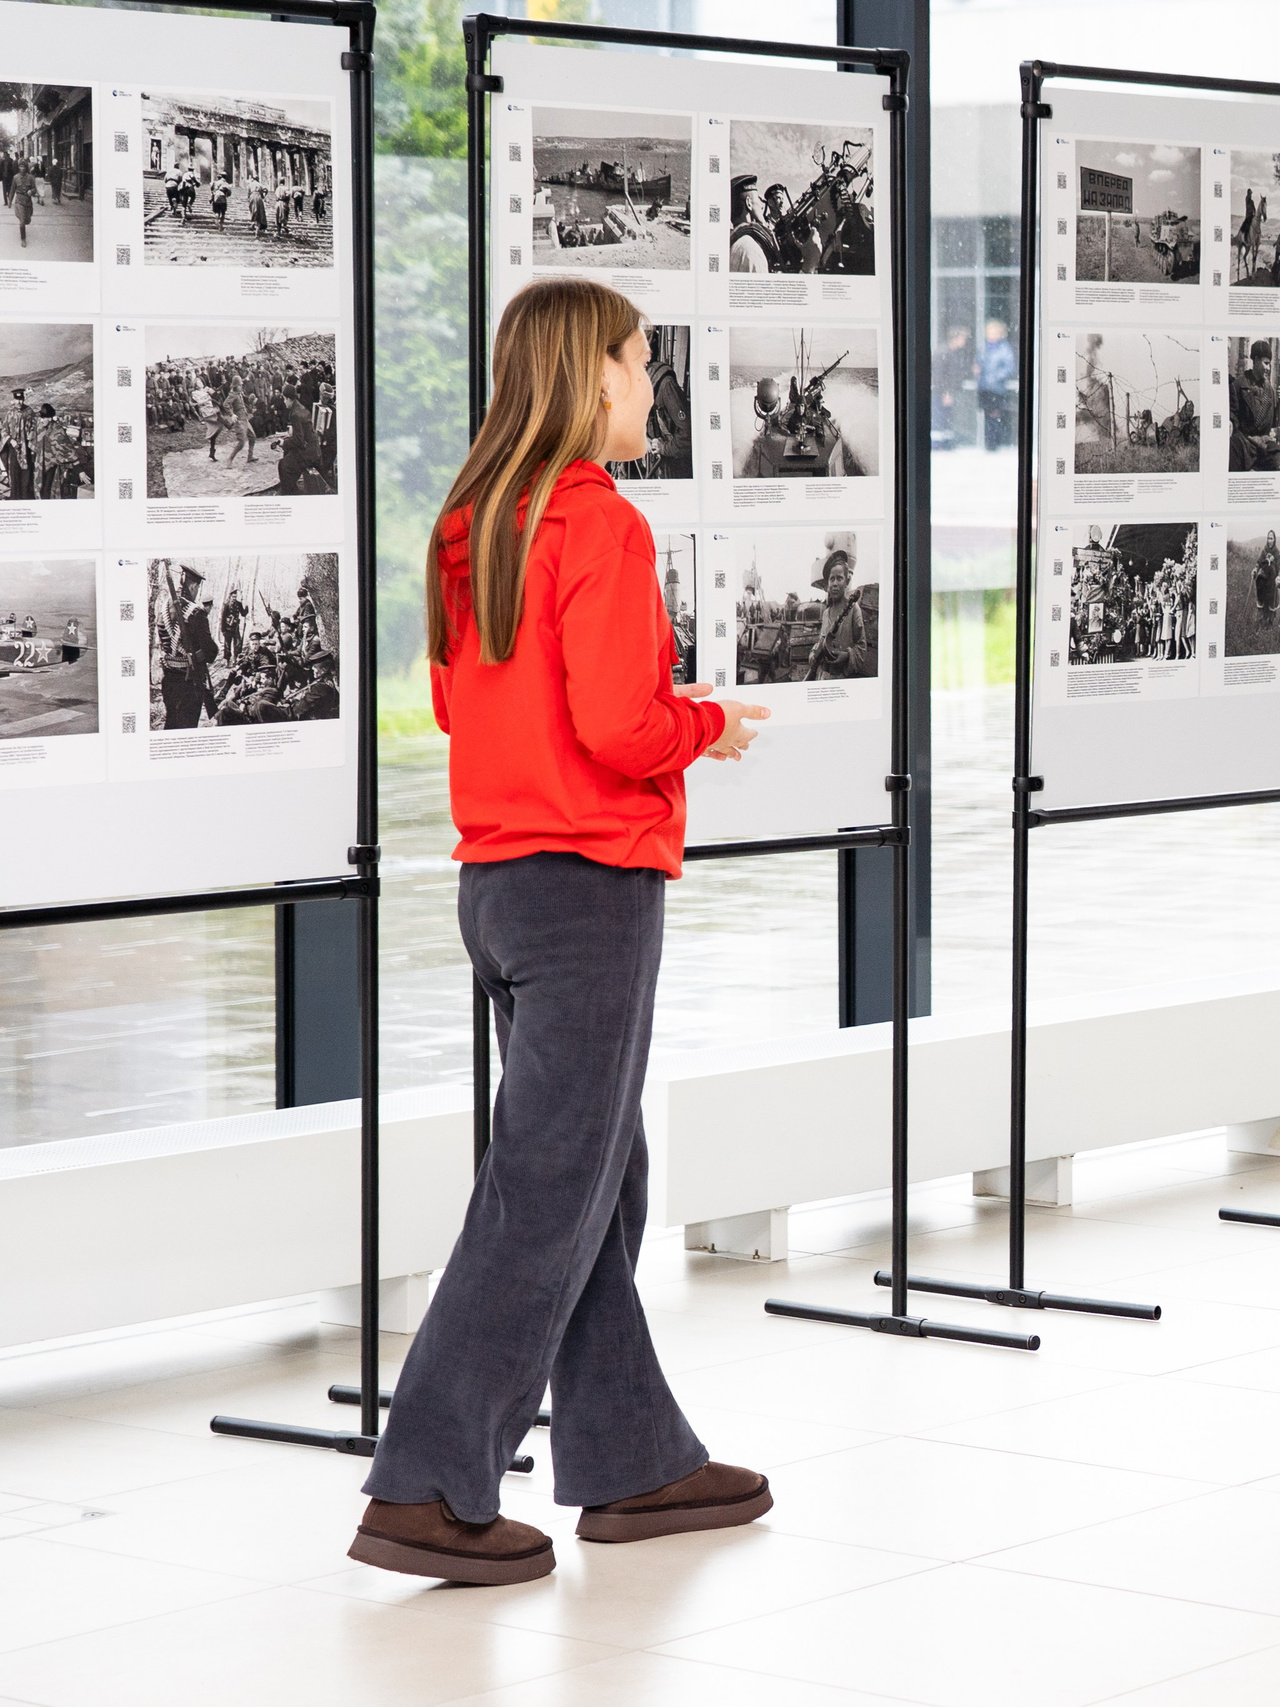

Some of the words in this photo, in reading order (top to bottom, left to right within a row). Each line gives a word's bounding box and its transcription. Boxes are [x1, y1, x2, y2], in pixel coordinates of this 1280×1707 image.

[1089, 172, 1128, 191] ВПЕРЕД
[1083, 189, 1097, 206] НА
[1099, 192, 1130, 211] ЗАПАД
[13, 640, 35, 667] 22
